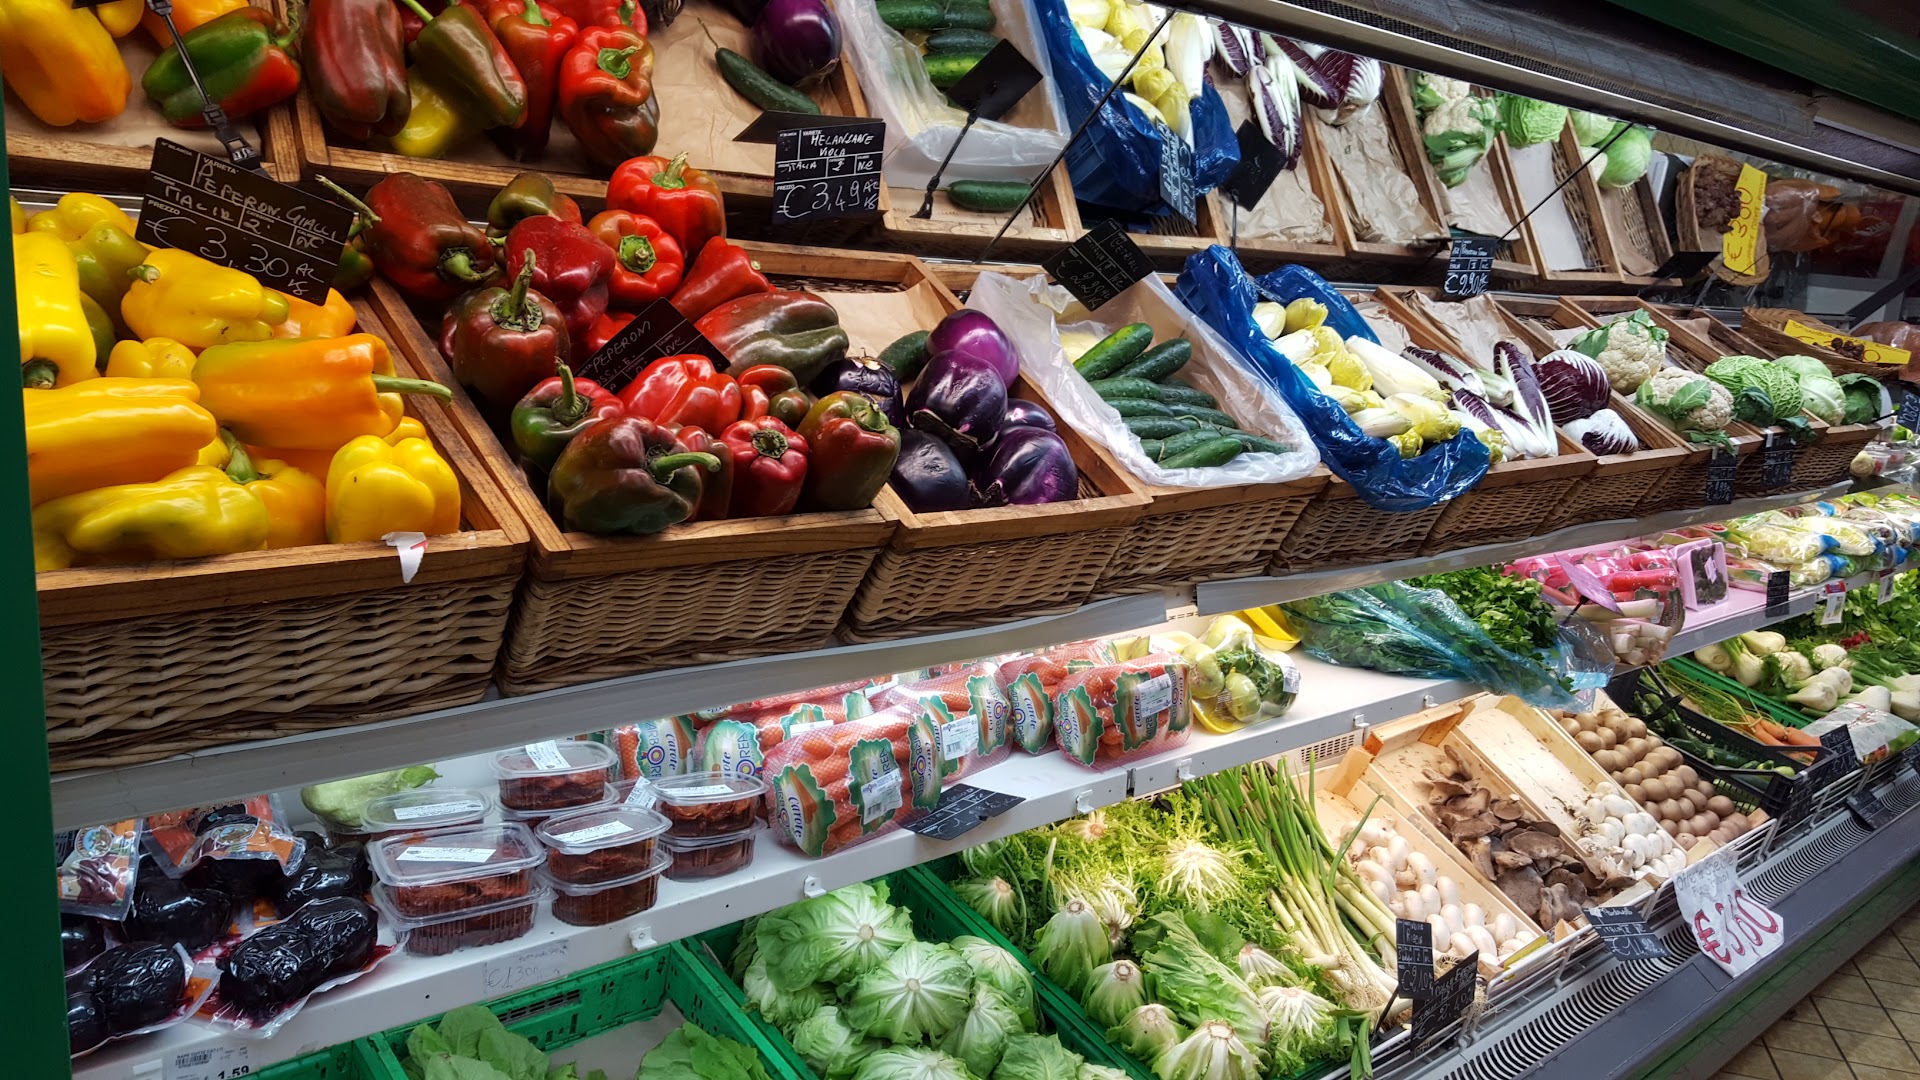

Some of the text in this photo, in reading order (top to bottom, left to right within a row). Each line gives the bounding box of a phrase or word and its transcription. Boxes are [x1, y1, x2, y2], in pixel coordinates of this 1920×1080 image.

[147, 199, 180, 215] PREZZO
[665, 733, 679, 771] Carote
[787, 796, 804, 839] Carote
